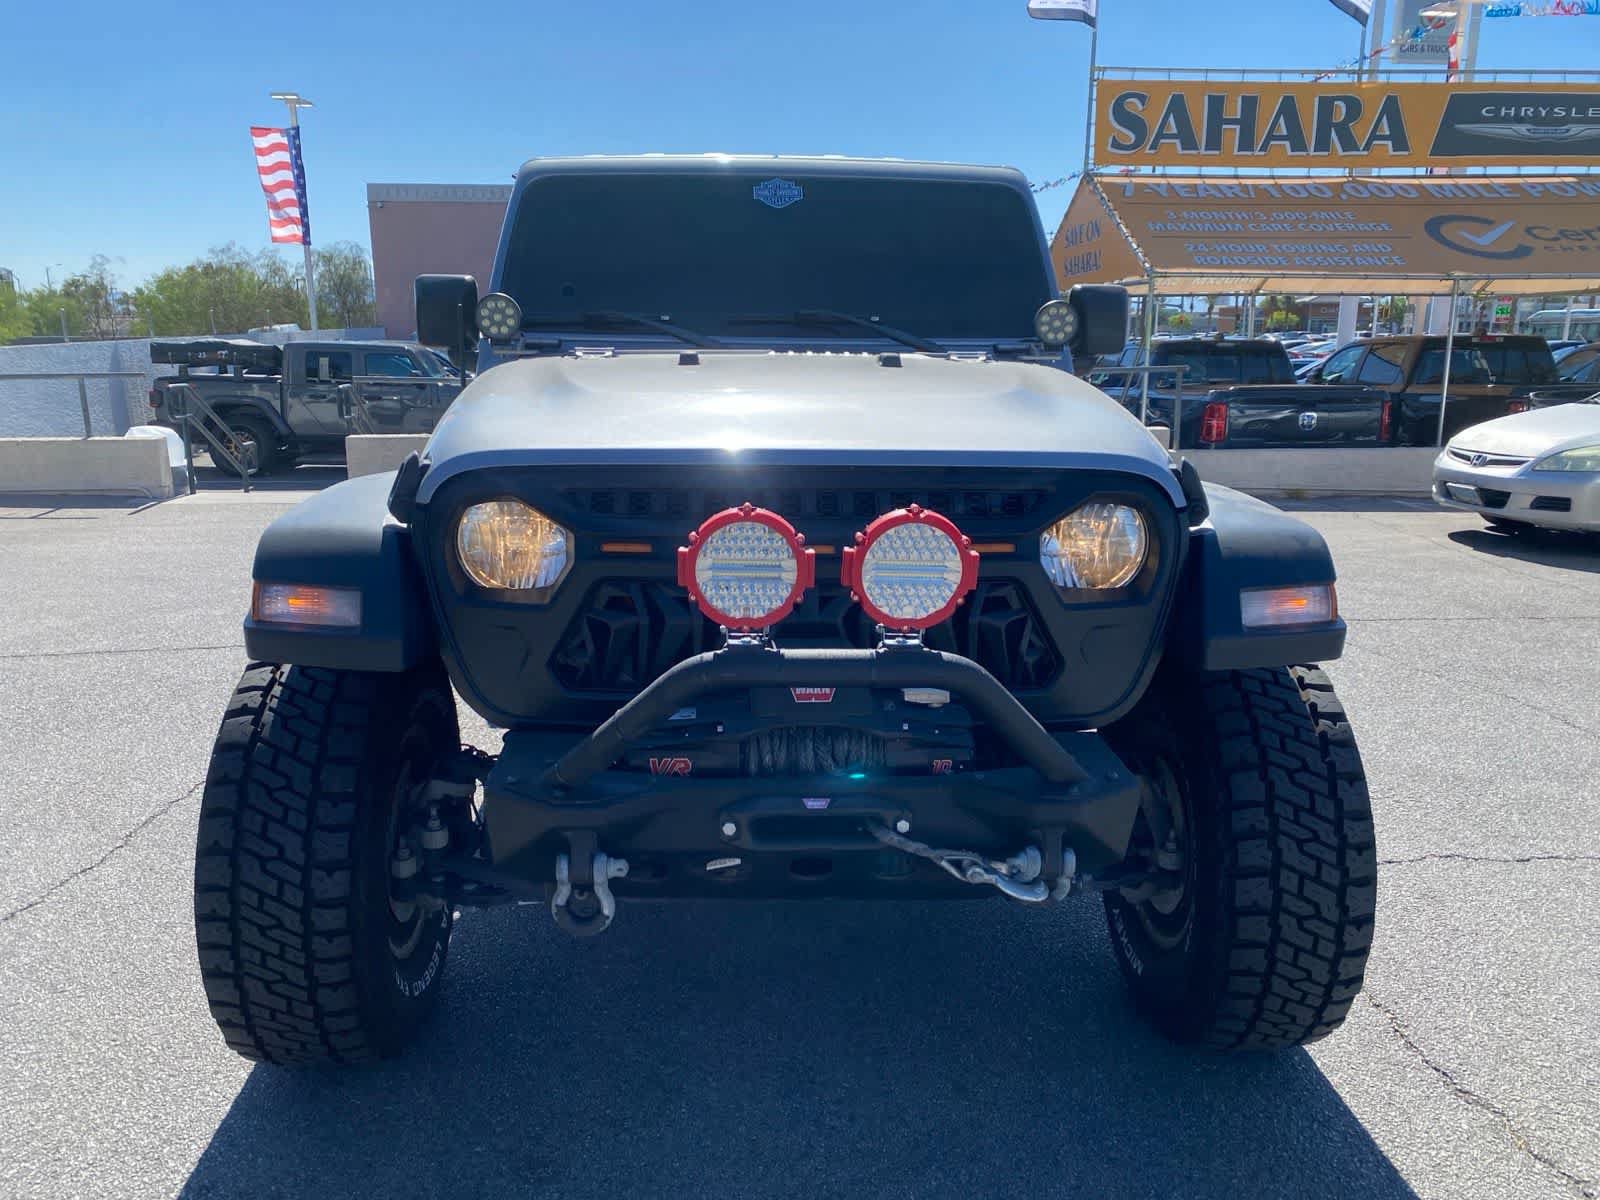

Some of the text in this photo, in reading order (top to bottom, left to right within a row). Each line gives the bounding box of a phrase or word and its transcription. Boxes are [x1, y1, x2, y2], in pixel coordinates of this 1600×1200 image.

[1108, 91, 1412, 155] SAHARA
[1423, 183, 1521, 198] MILE
[1064, 219, 1100, 246] SAVE ON
[1148, 223, 1393, 233] MAXIMUM CARE COVERAGE
[1524, 224, 1600, 241] Cer
[1185, 242, 1393, 254] 24-HOUR TOWING AND
[1194, 255, 1407, 267] ROADSIDE ASSISTANCE
